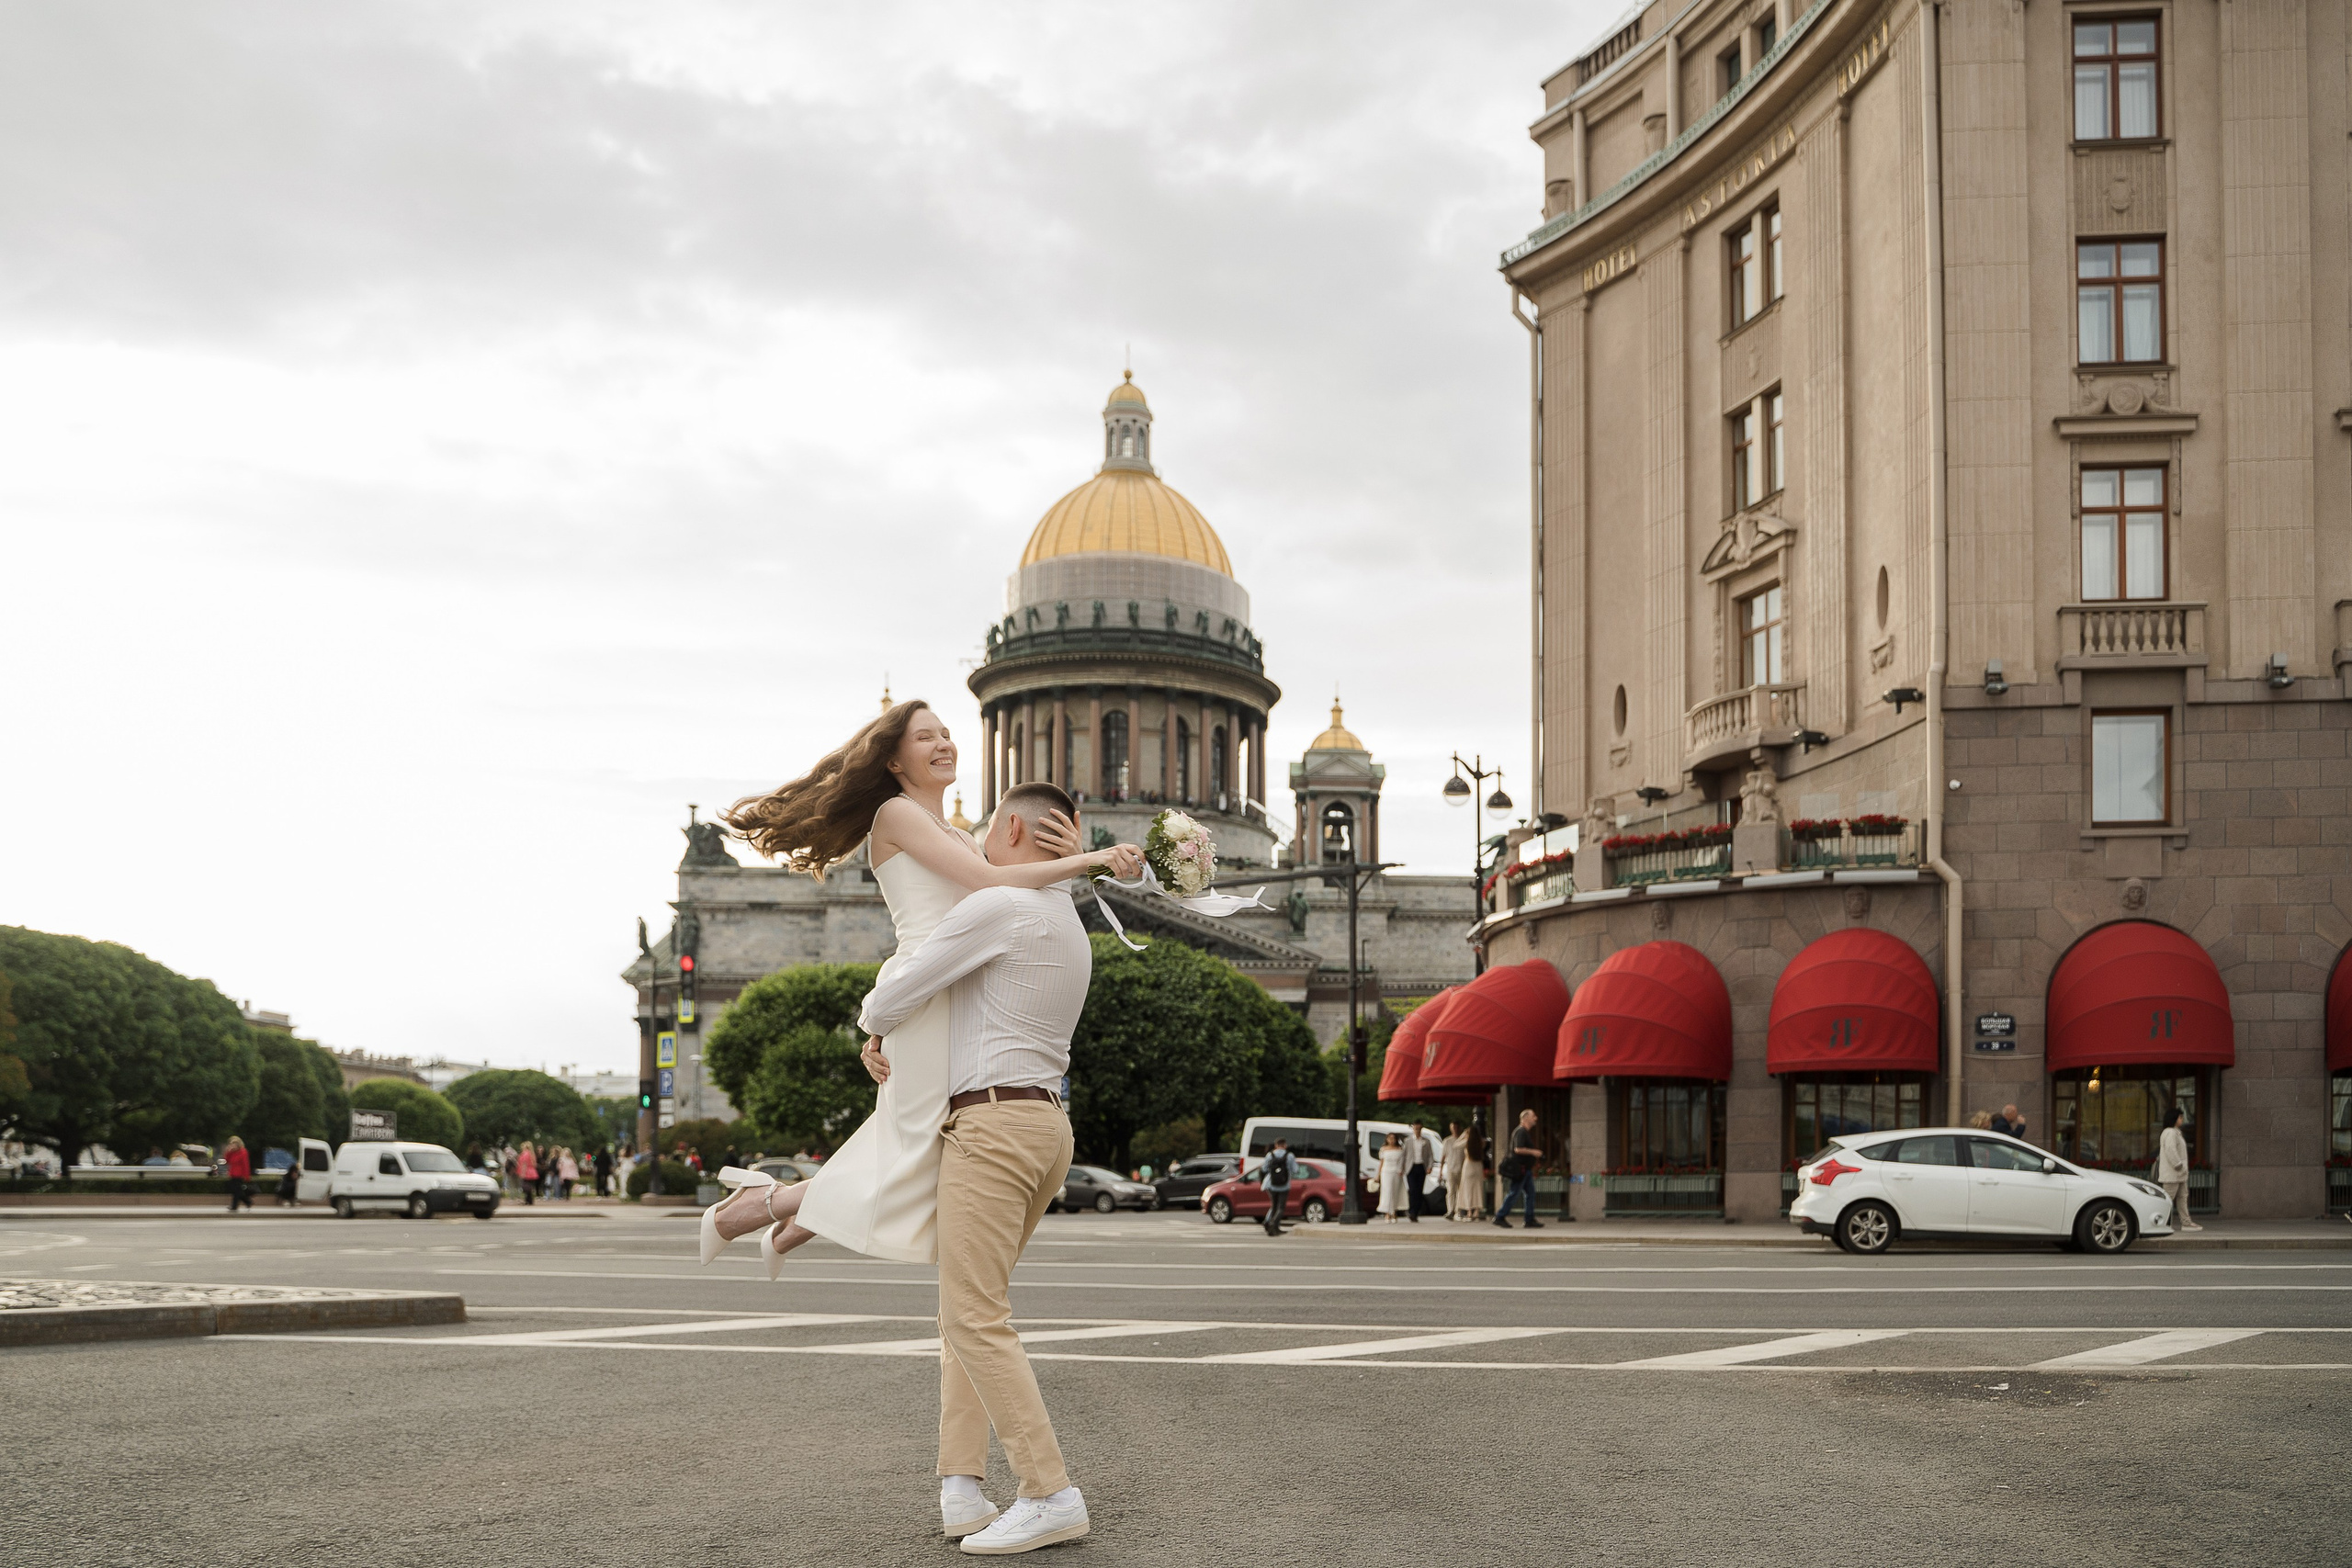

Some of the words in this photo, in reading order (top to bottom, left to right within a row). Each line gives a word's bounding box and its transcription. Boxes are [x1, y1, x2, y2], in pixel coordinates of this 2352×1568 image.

[1838, 19, 1888, 98] HOTEL
[1683, 123, 1795, 231] ASTORIA
[1583, 243, 1636, 292] HOTEL
